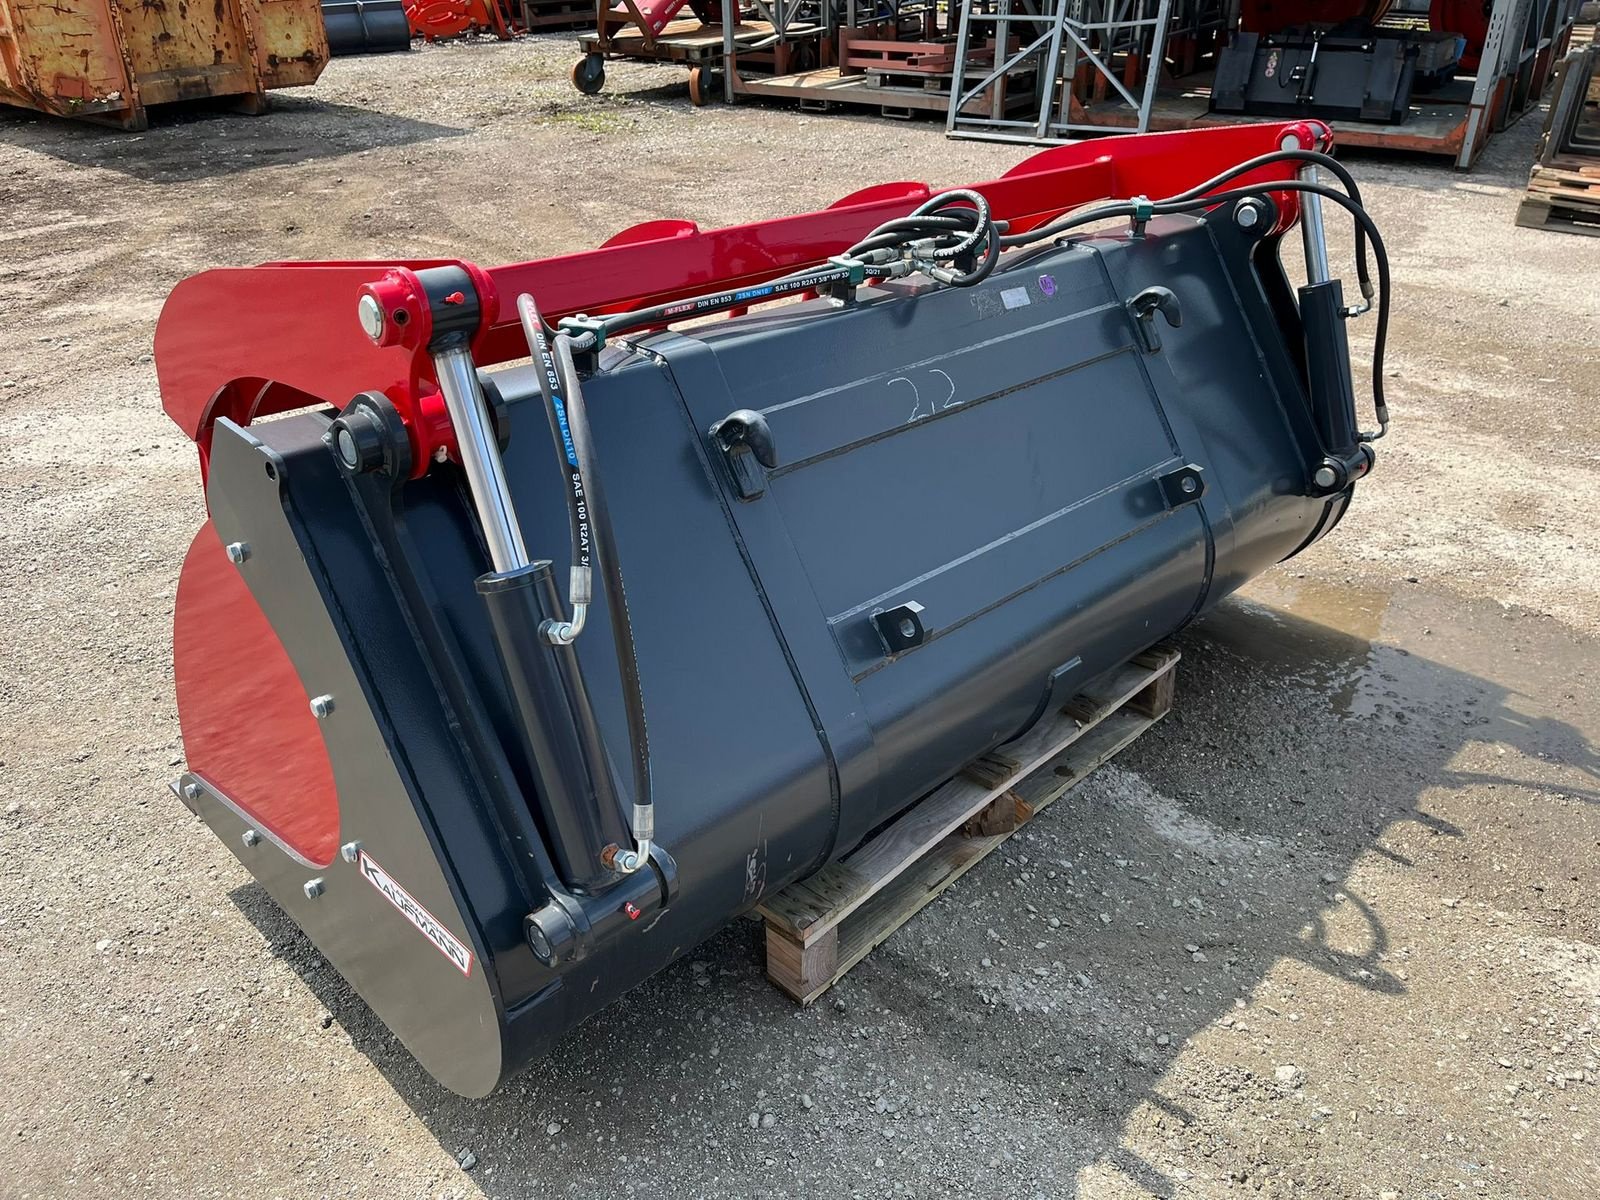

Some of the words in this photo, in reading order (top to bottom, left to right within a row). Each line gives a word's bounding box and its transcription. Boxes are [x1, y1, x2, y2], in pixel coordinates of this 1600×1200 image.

[697, 299, 709, 308] DIN
[710, 297, 720, 306] EN
[720, 295, 732, 304] 853
[775, 284, 788, 292] SAE
[789, 281, 801, 289] 100
[801, 278, 817, 287] R2AT
[831, 273, 841, 281] WP
[536, 332, 547, 350] DIN
[541, 352, 553, 368] EN
[547, 370, 559, 390] 853
[556, 402, 568, 425] 2SN
[562, 429, 576, 459] DN10
[572, 473, 584, 497] SAE
[577, 500, 587, 520] 100
[579, 522, 589, 553] R2AT
[362, 857, 466, 969] KAUFMANN
